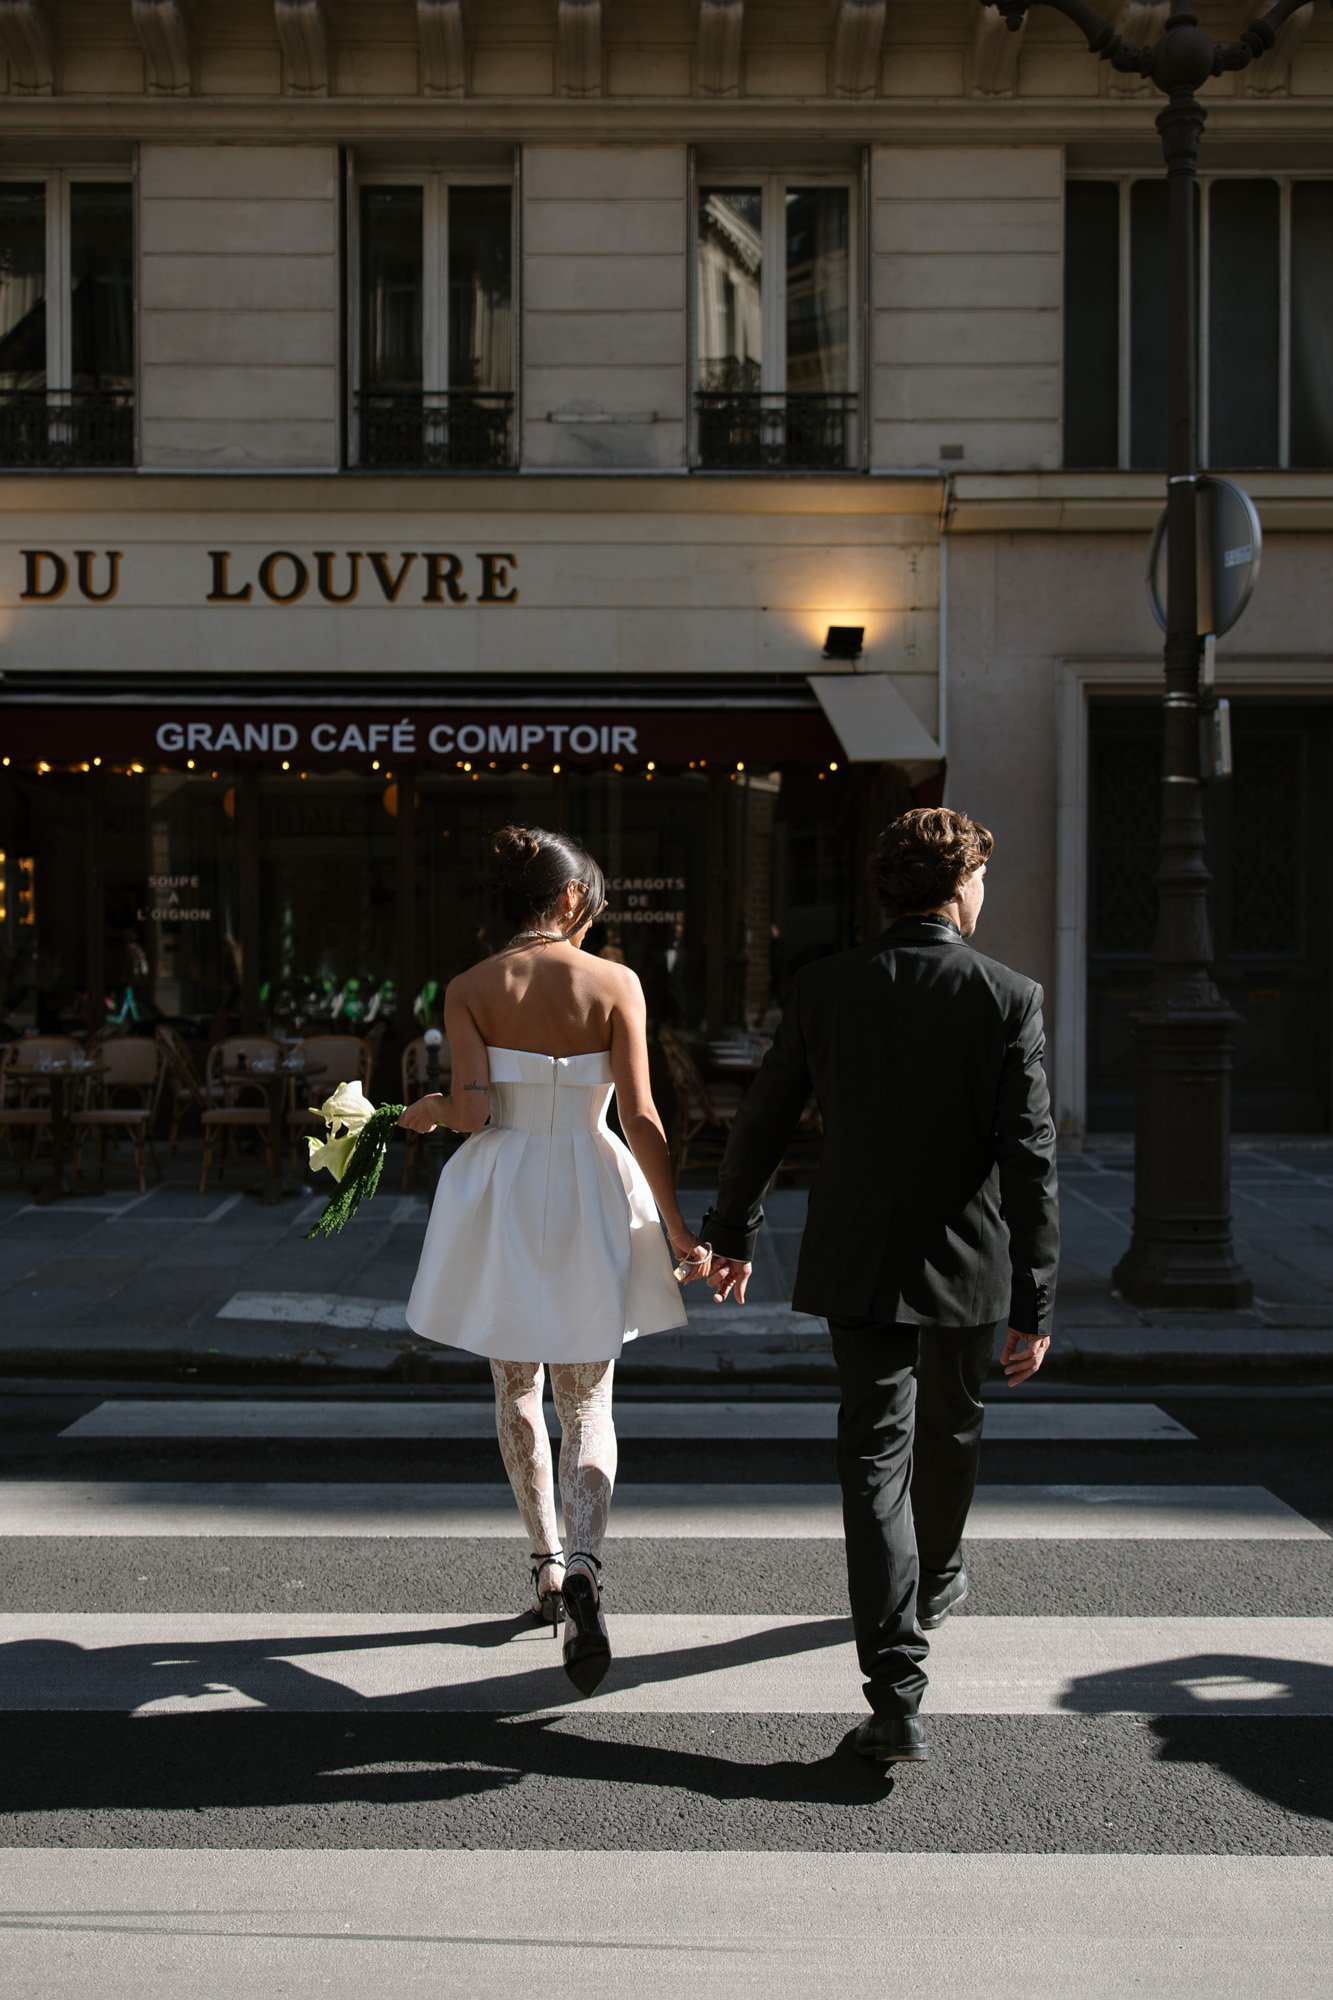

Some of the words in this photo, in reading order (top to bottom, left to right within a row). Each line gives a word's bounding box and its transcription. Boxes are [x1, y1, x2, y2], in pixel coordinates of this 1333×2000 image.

[20, 551, 122, 602] DU
[206, 551, 518, 602] LOUVRE
[156, 723, 298, 751] GRAND
[311, 718, 416, 753] CAFÉ
[428, 725, 638, 753] COMPTOIR
[148, 875, 200, 888] SOUPE
[604, 878, 685, 891] SCARGOTS
[628, 894, 649, 907] DE
